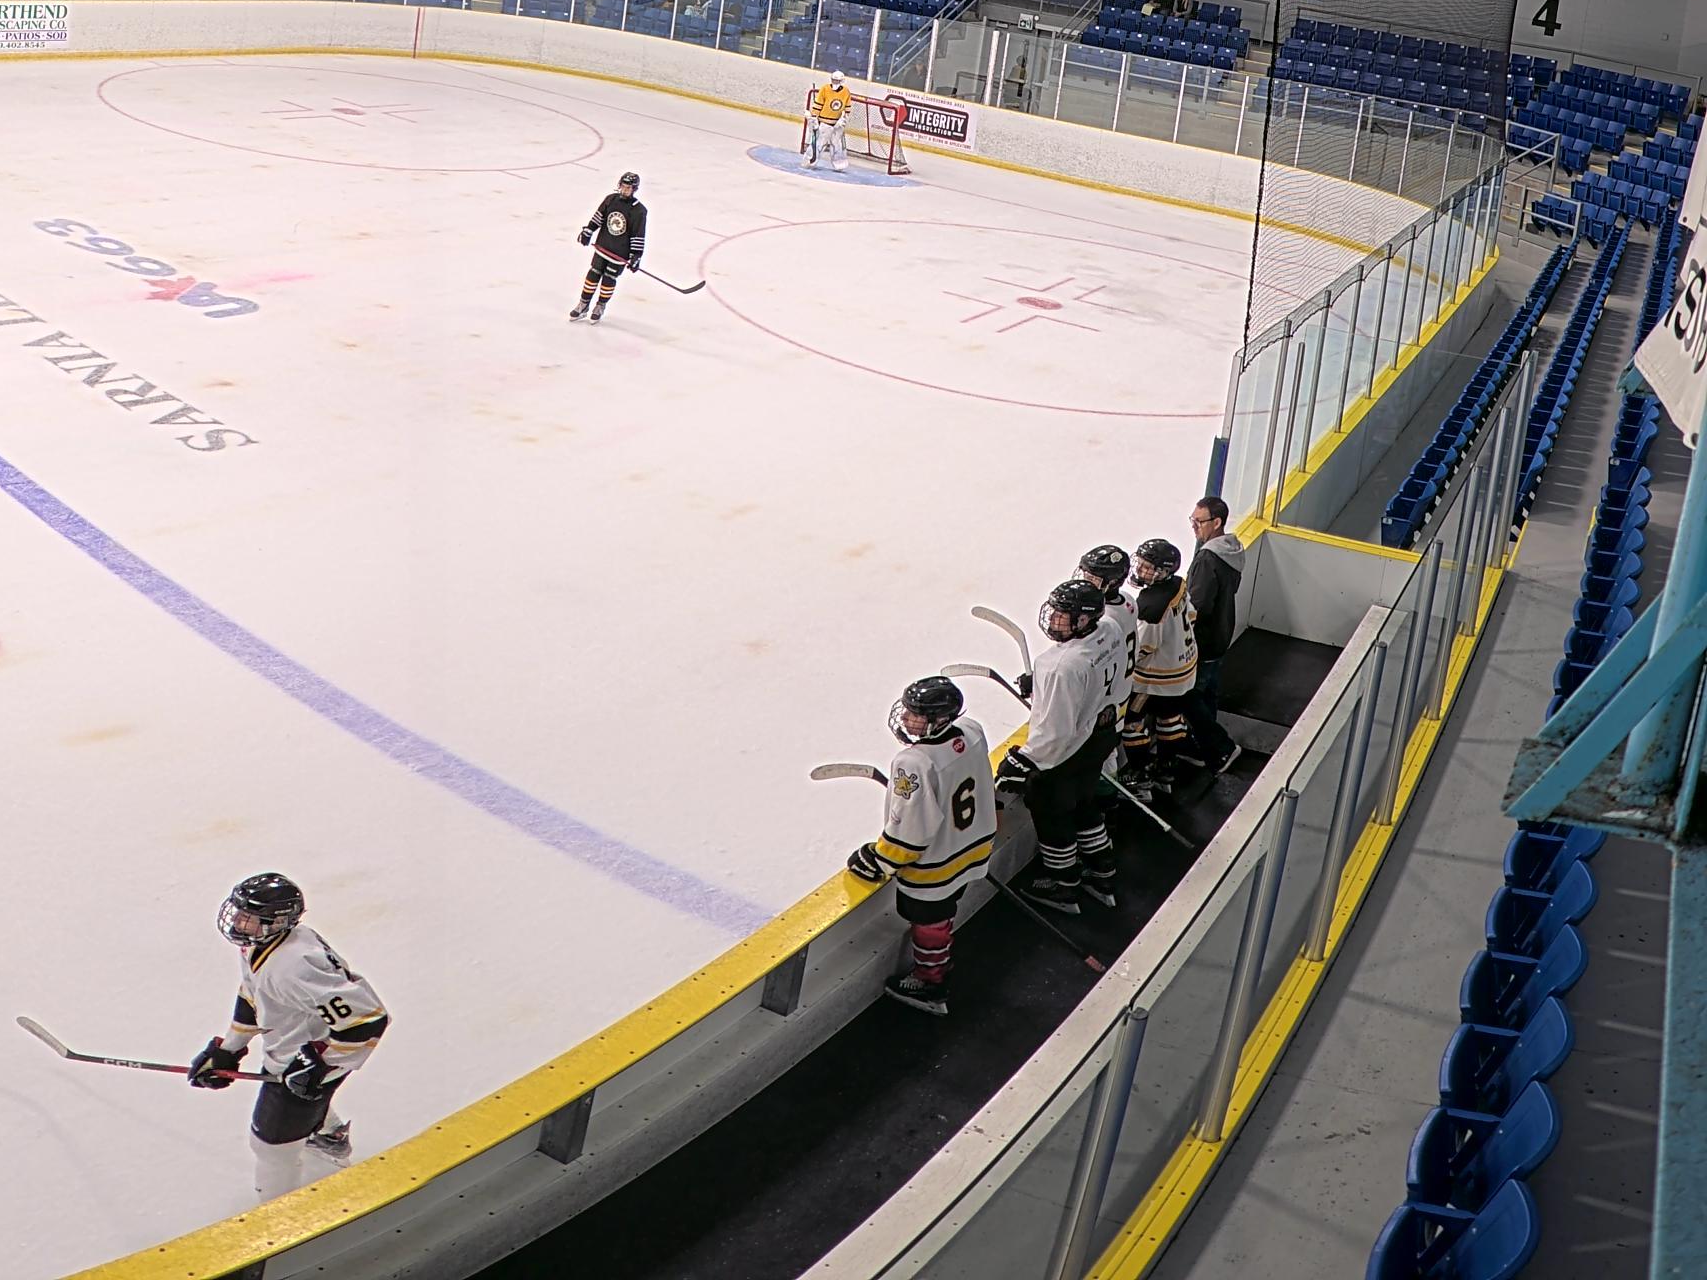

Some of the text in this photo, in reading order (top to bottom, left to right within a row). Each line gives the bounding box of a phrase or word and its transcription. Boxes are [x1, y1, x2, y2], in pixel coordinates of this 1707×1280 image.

[49, 20, 67, 29] CO.
[5, 32, 40, 40] PATIOS
[909, 108, 964, 132] INTEGRITY
[915, 124, 951, 136] INSULATION
[22, 329, 260, 453] SARNIA
[952, 777, 975, 831] 6
[104, 1058, 142, 1068] CCM
